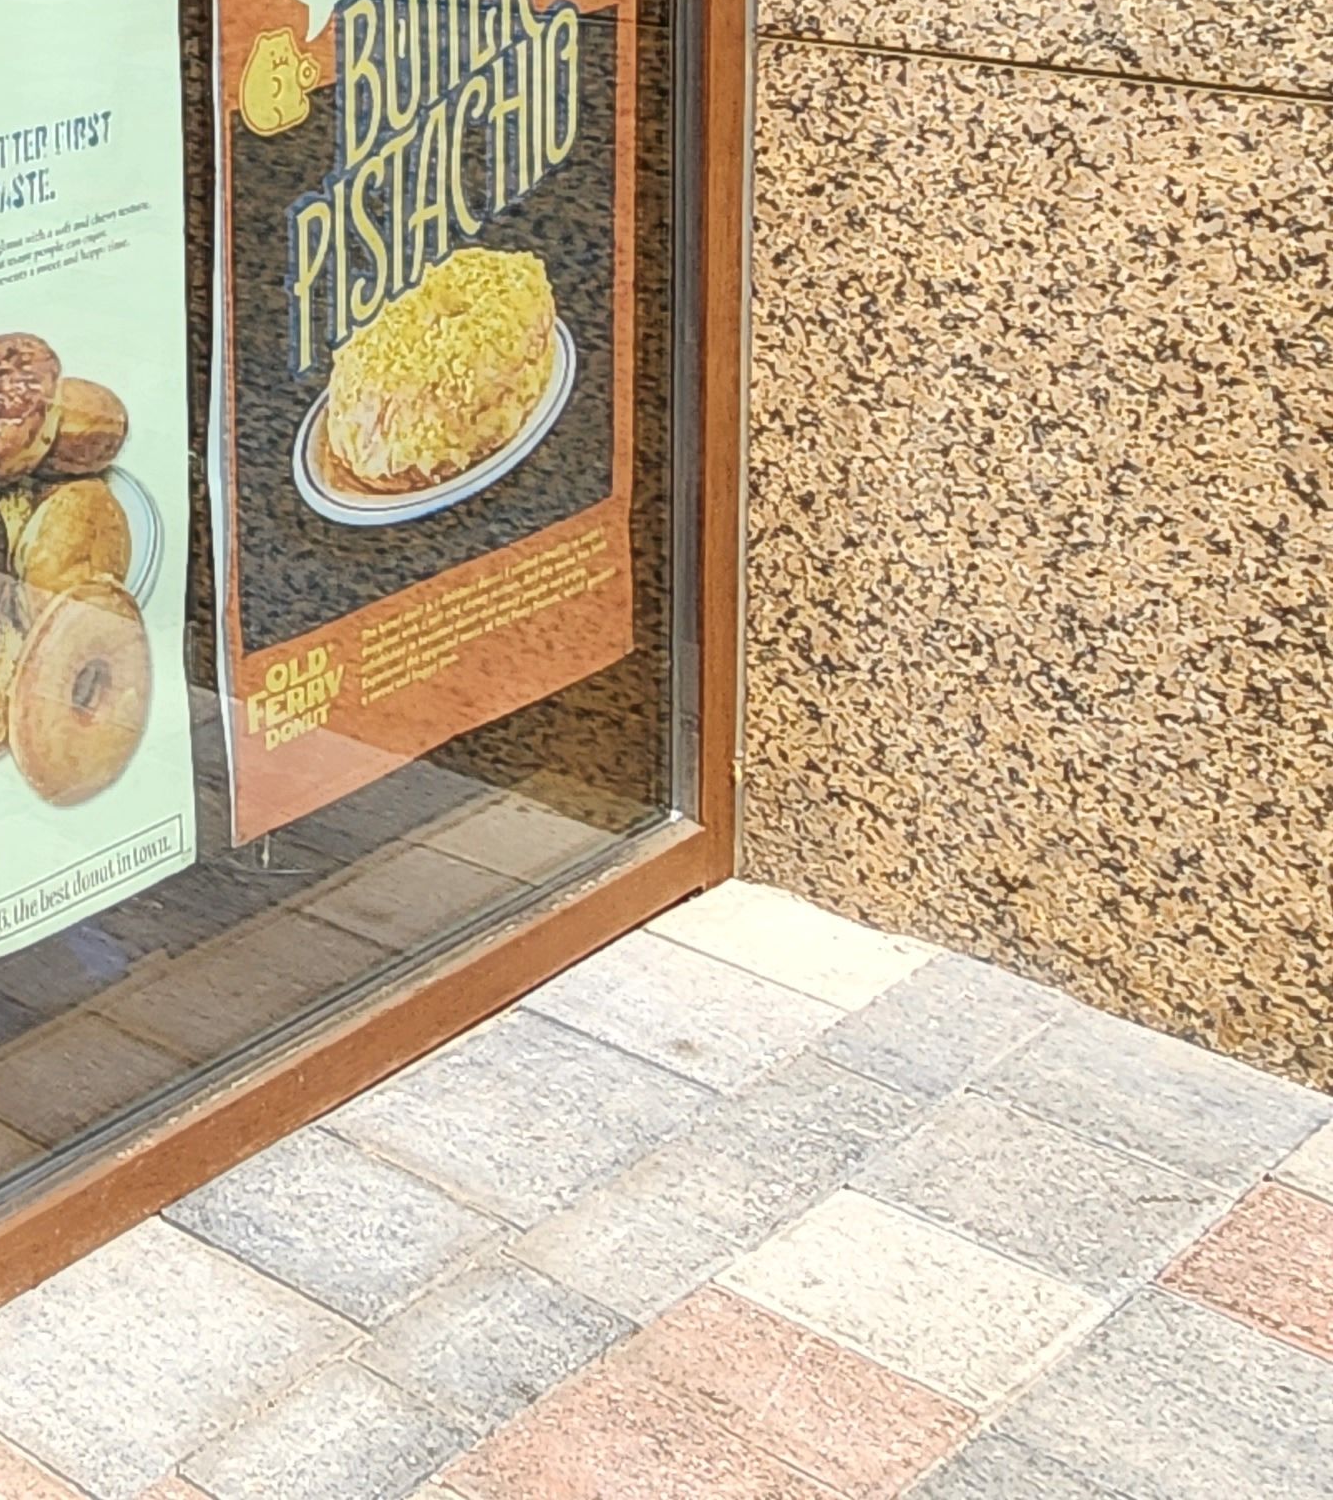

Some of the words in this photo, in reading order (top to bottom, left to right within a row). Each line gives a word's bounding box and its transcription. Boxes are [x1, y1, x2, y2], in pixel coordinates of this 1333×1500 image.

[55, 110, 112, 155] FIRST
[294, 8, 579, 374] PISTACHIO
[265, 648, 328, 692] OLD
[247, 664, 345, 735] FERRY
[264, 706, 329, 751] DONUT
[13, 898, 38, 925] the
[39, 883, 71, 913] best
[72, 859, 115, 897] donut
[115, 851, 132, 875] in
[132, 835, 172, 864] town.
